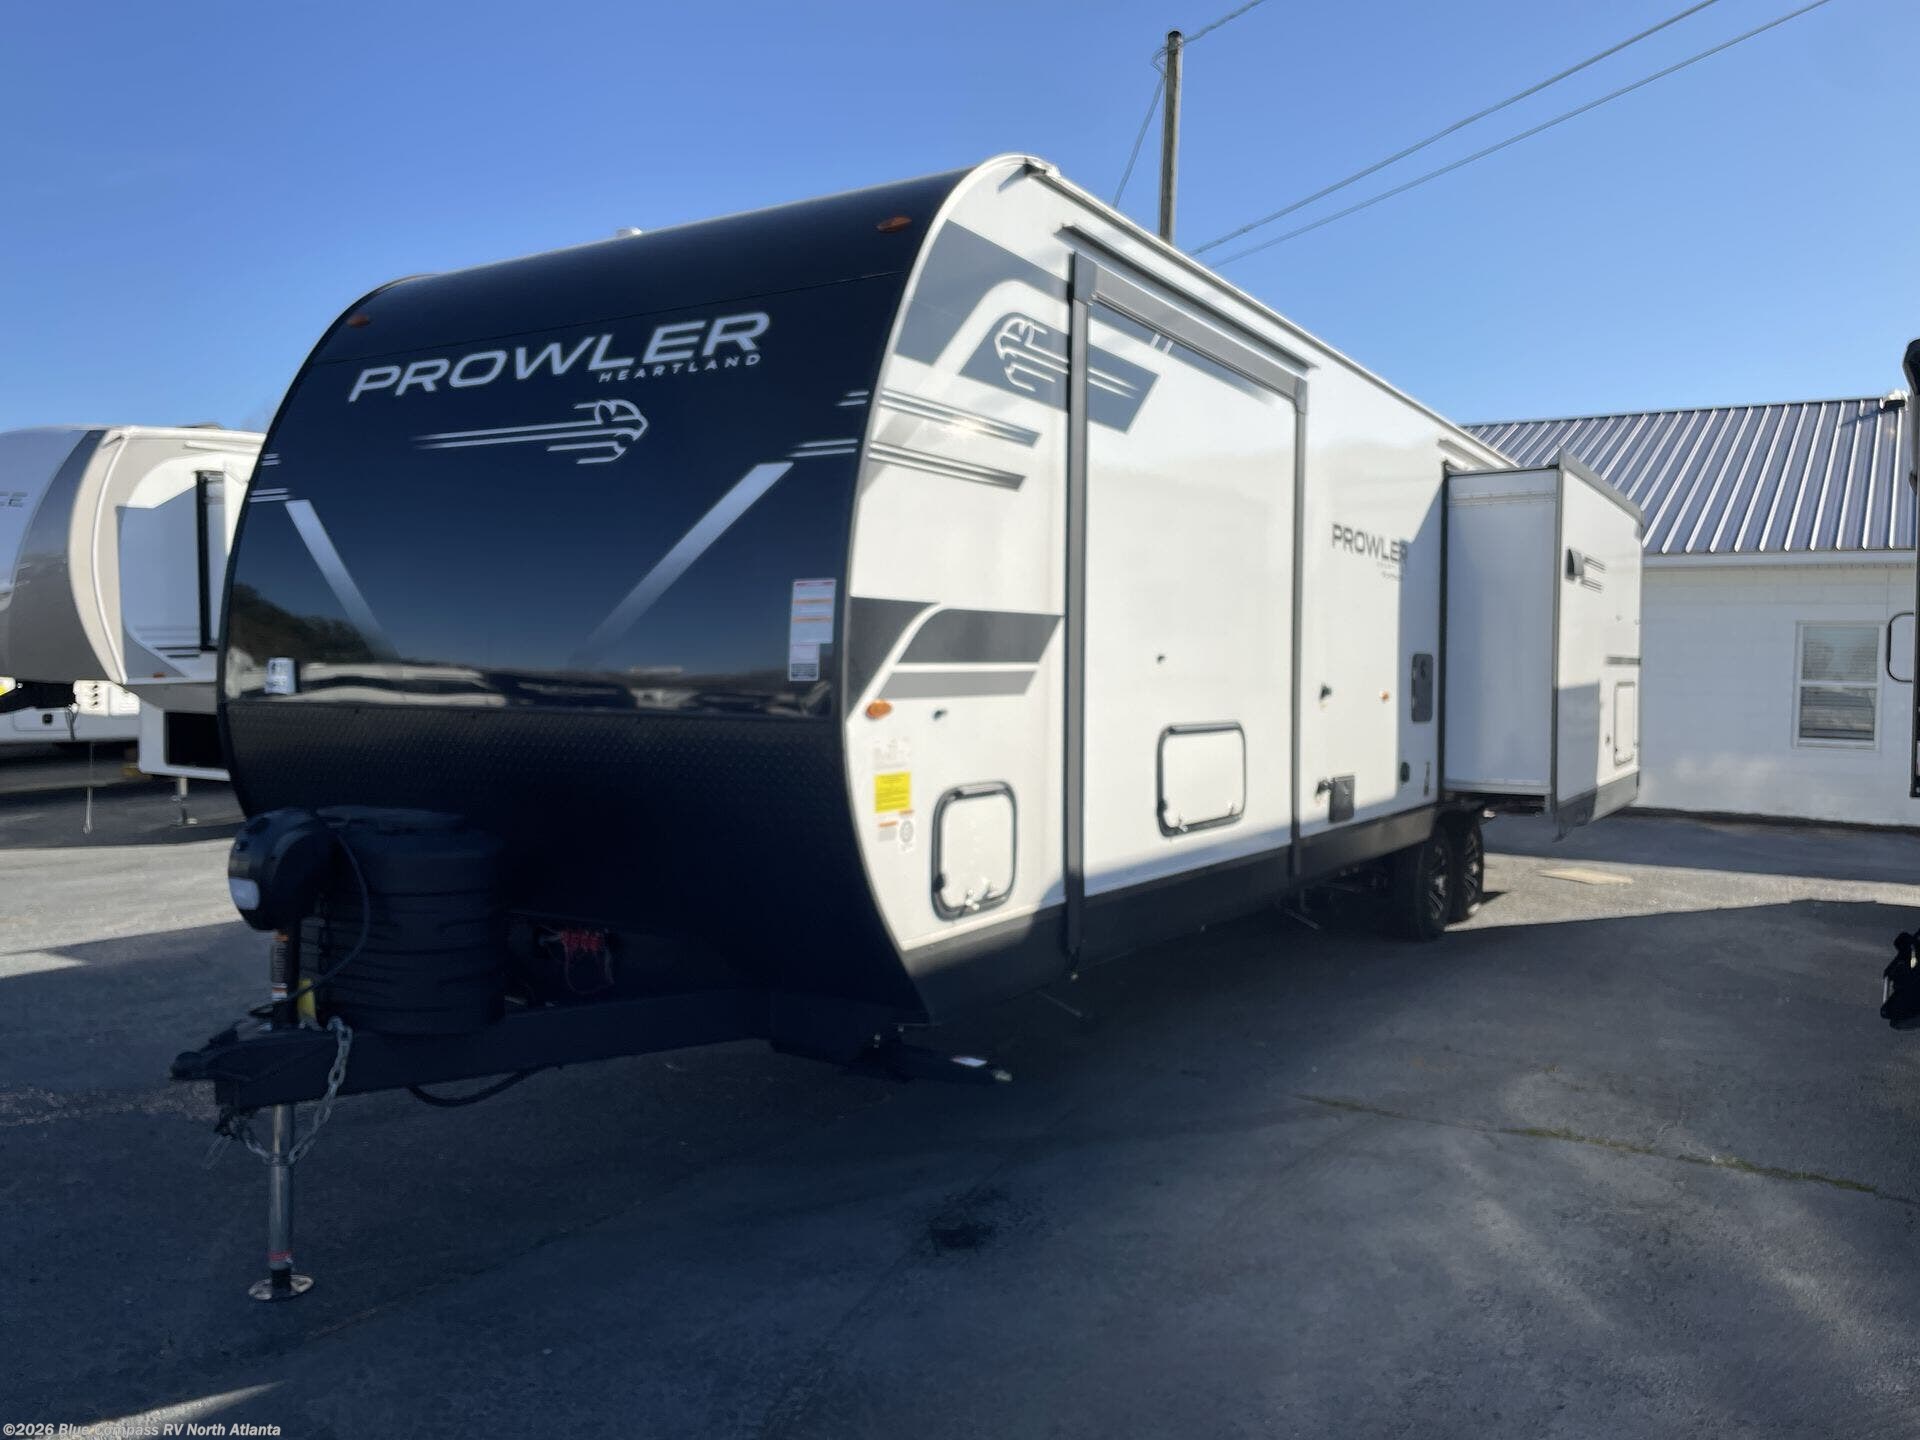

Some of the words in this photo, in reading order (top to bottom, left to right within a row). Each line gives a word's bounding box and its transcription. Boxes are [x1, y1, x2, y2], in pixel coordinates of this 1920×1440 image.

[348, 311, 771, 403] PROWLER
[597, 353, 762, 384] HEARTLAND
[1331, 523, 1409, 563] PROWLER
